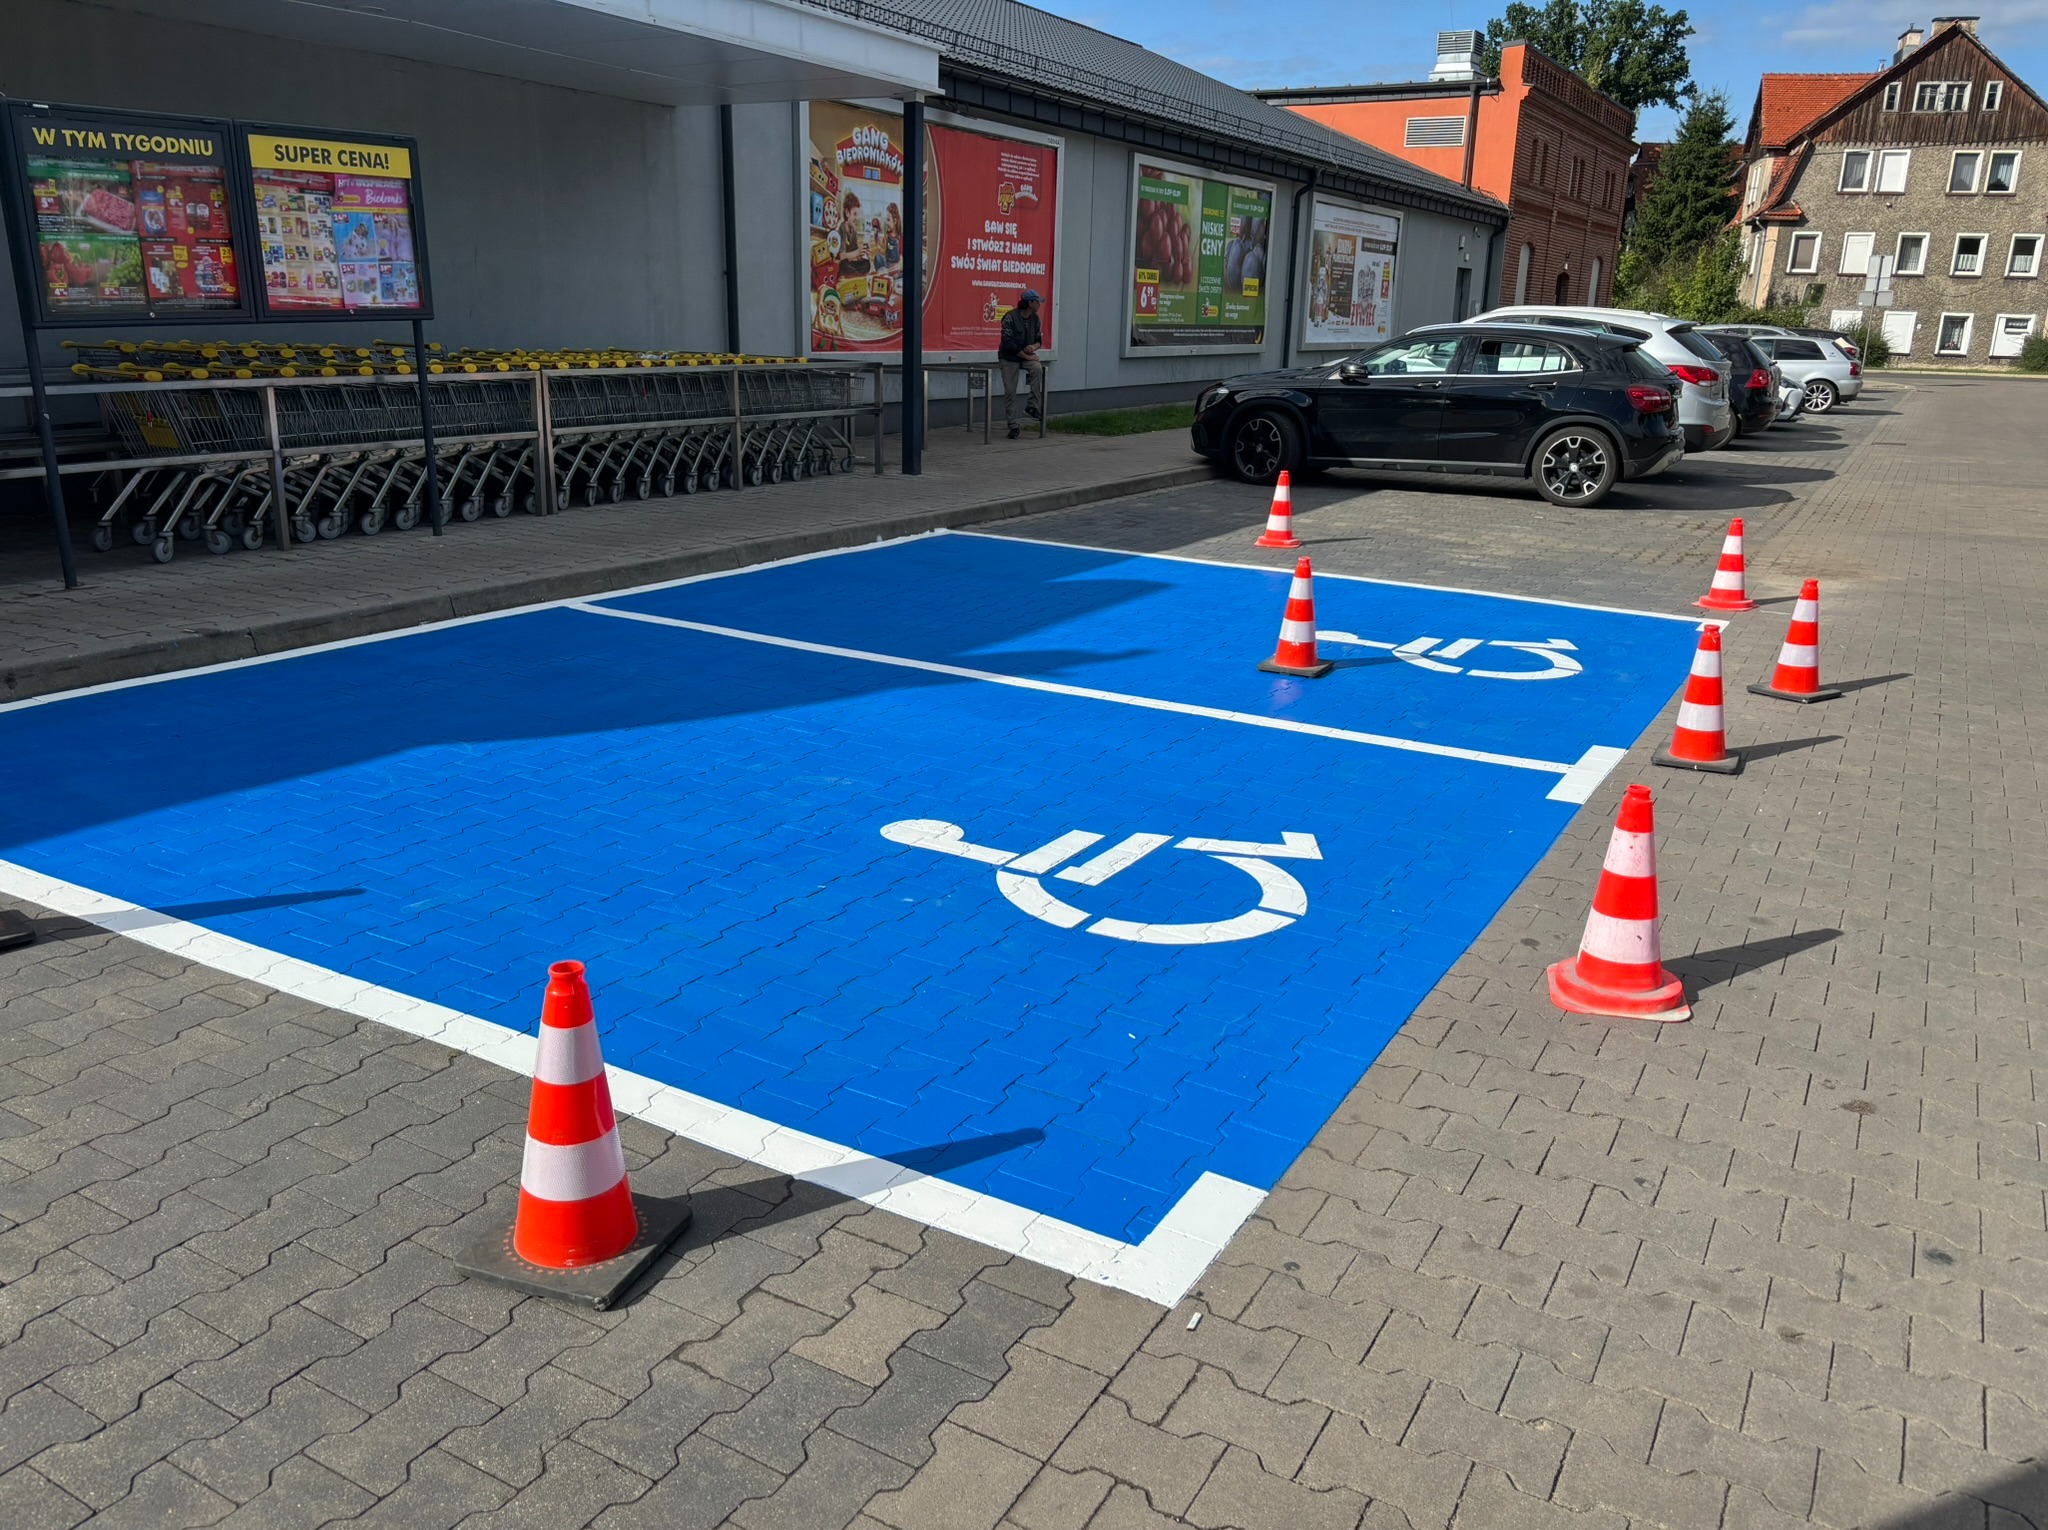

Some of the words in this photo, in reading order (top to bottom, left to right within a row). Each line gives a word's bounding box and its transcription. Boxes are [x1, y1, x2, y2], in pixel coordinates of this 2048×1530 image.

[32, 127, 56, 146] W
[61, 129, 107, 150] TYM
[111, 132, 214, 157] TYGODNIU
[852, 126, 889, 151] GANG
[274, 144, 332, 165] SUPER
[337, 149, 390, 170] CENA!
[984, 220, 1004, 235] BAW
[1005, 221, 1018, 239] SIĘ
[1202, 220, 1224, 237] NISKIE
[967, 238, 971, 250] I
[971, 236, 1004, 253] STWÓRZ
[1005, 242, 1011, 254] Z
[1011, 243, 1033, 256] NAMI
[1200, 238, 1224, 257] CENY
[951, 252, 976, 269] SWÓJ
[976, 254, 1002, 272] ŚWIAT
[1002, 260, 1046, 275] BIEDRONKI!
